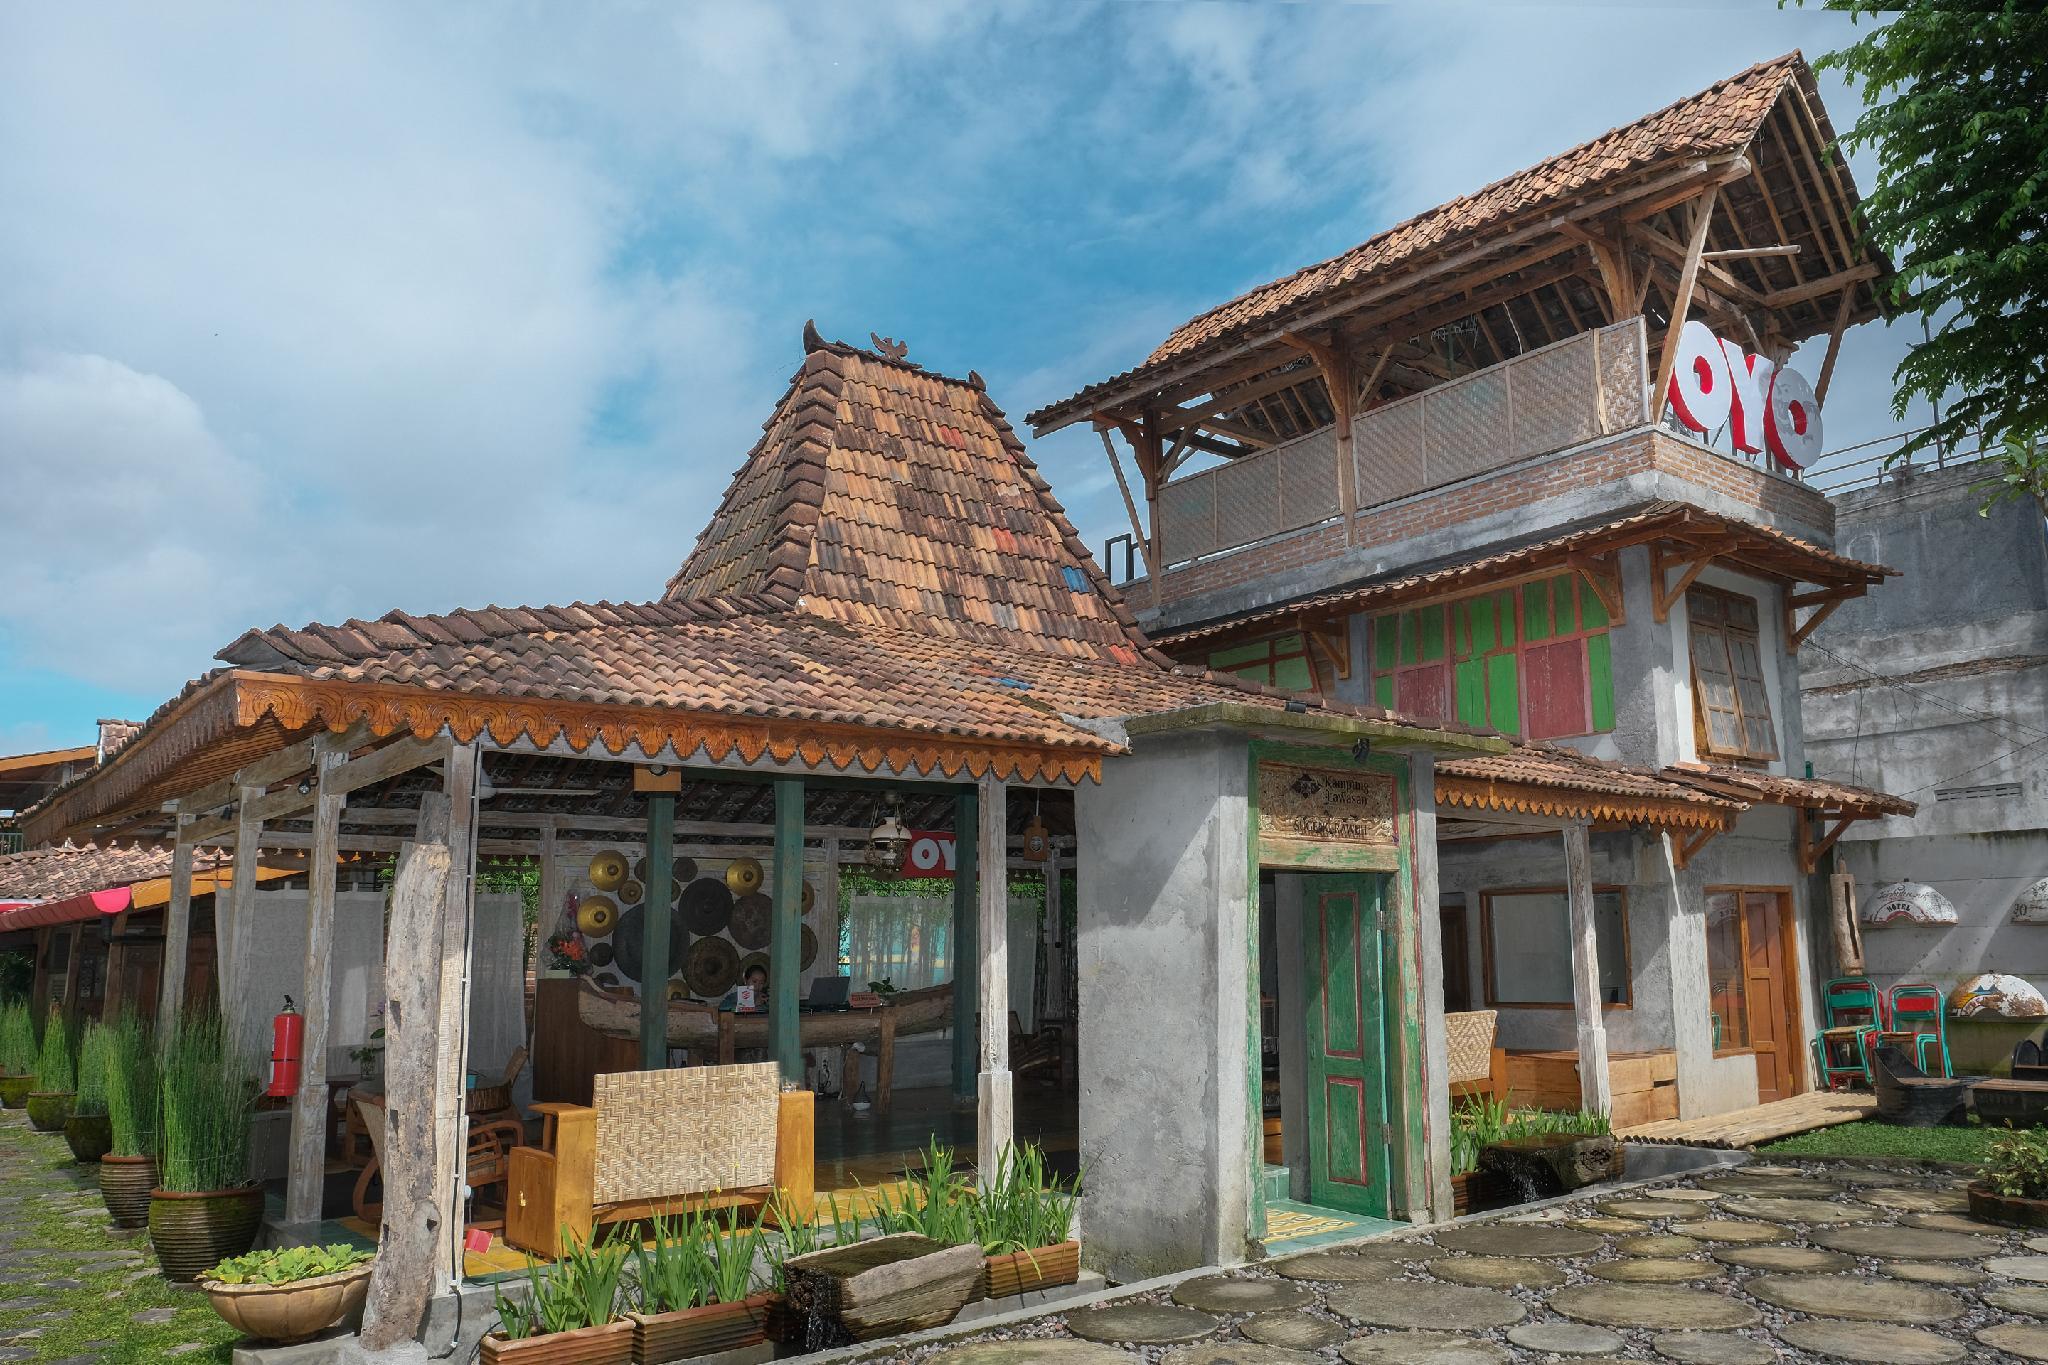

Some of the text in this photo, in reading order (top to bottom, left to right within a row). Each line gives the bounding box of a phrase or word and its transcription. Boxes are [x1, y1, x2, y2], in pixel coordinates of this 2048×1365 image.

[1669, 320, 1823, 469] OYO
[1325, 775, 1369, 794] Kampung
[911, 838, 979, 871] OY
[1886, 903, 1911, 912] HOTEL
